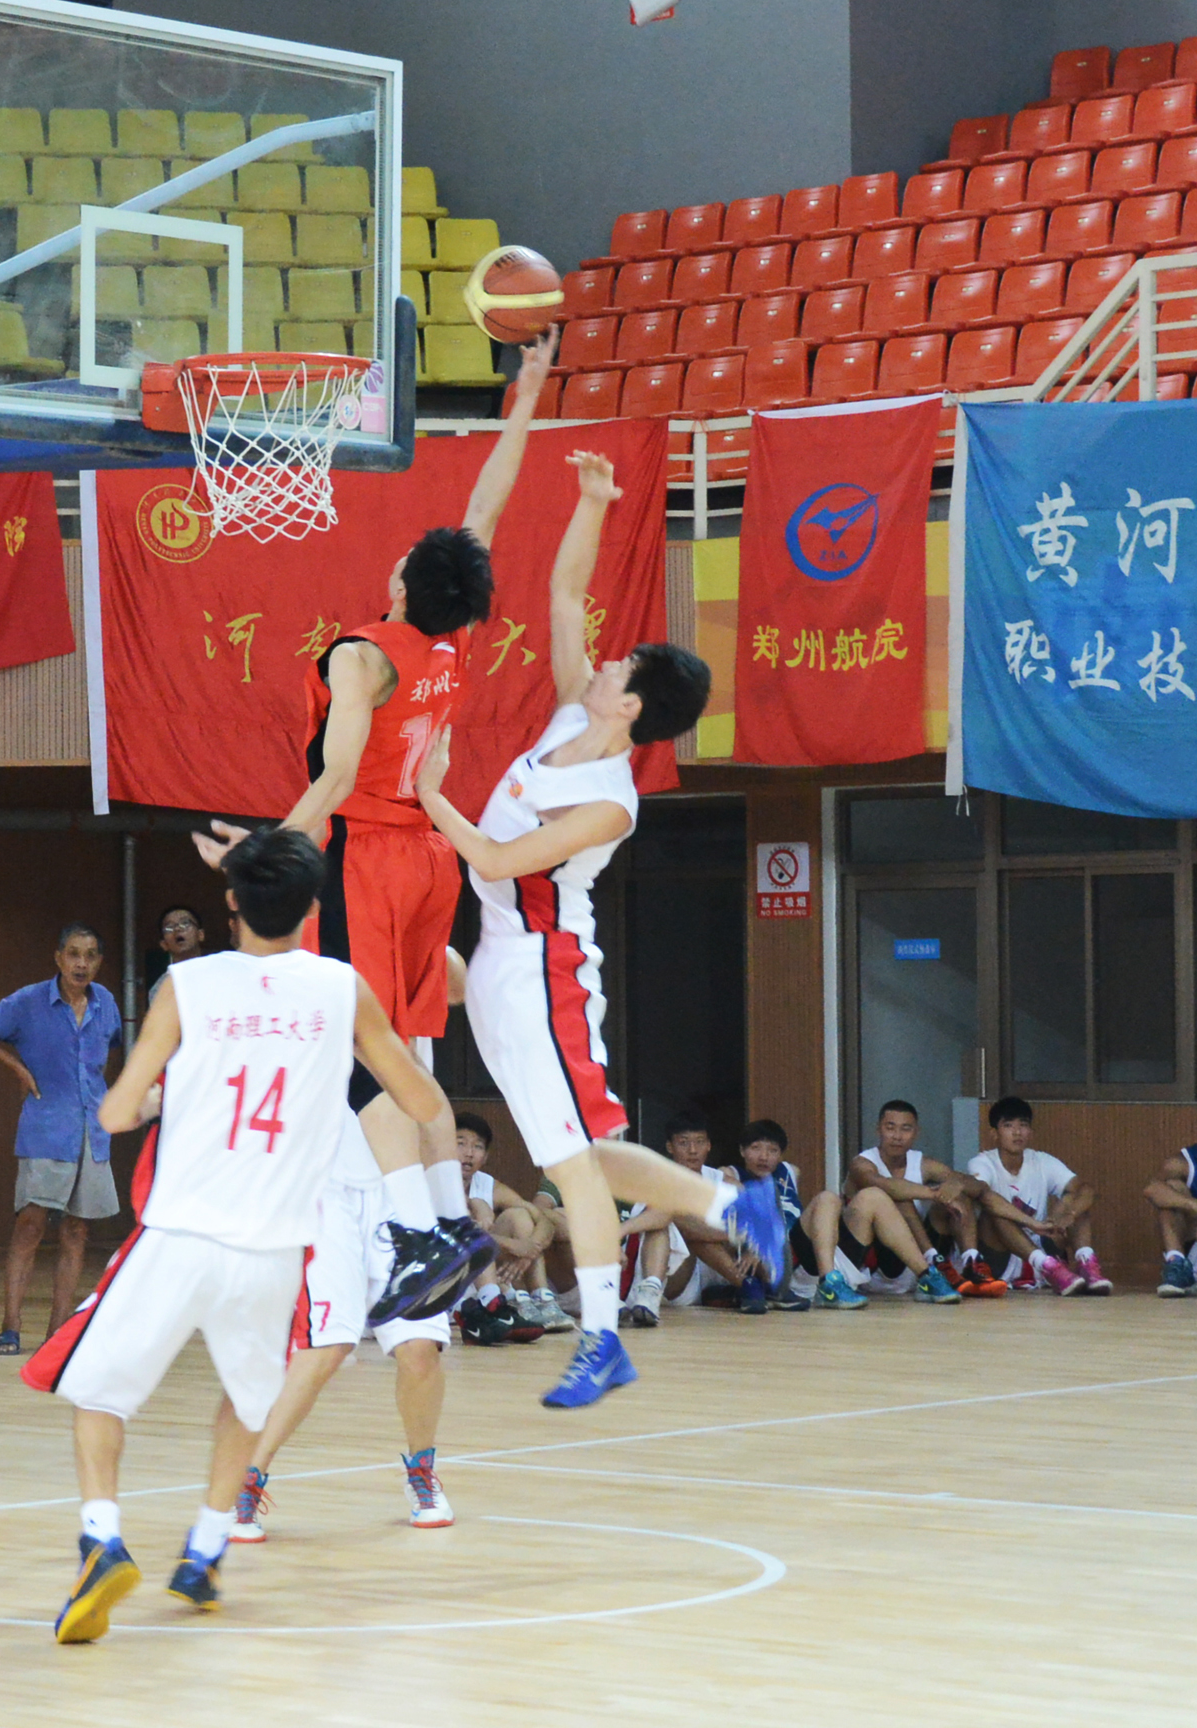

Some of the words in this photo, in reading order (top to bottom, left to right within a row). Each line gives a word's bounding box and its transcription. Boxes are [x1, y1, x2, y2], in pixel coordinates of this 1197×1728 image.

[1016, 480, 1197, 588] 黄河
[818, 550, 848, 561] ZIA
[752, 618, 908, 671] 郑州航院
[1004, 618, 1196, 703] 职业技
[761, 896, 807, 909] 禁止吸烟
[773, 908, 807, 916] SMOKING
[227, 1064, 286, 1154] 14
[313, 1301, 331, 1332] 7
